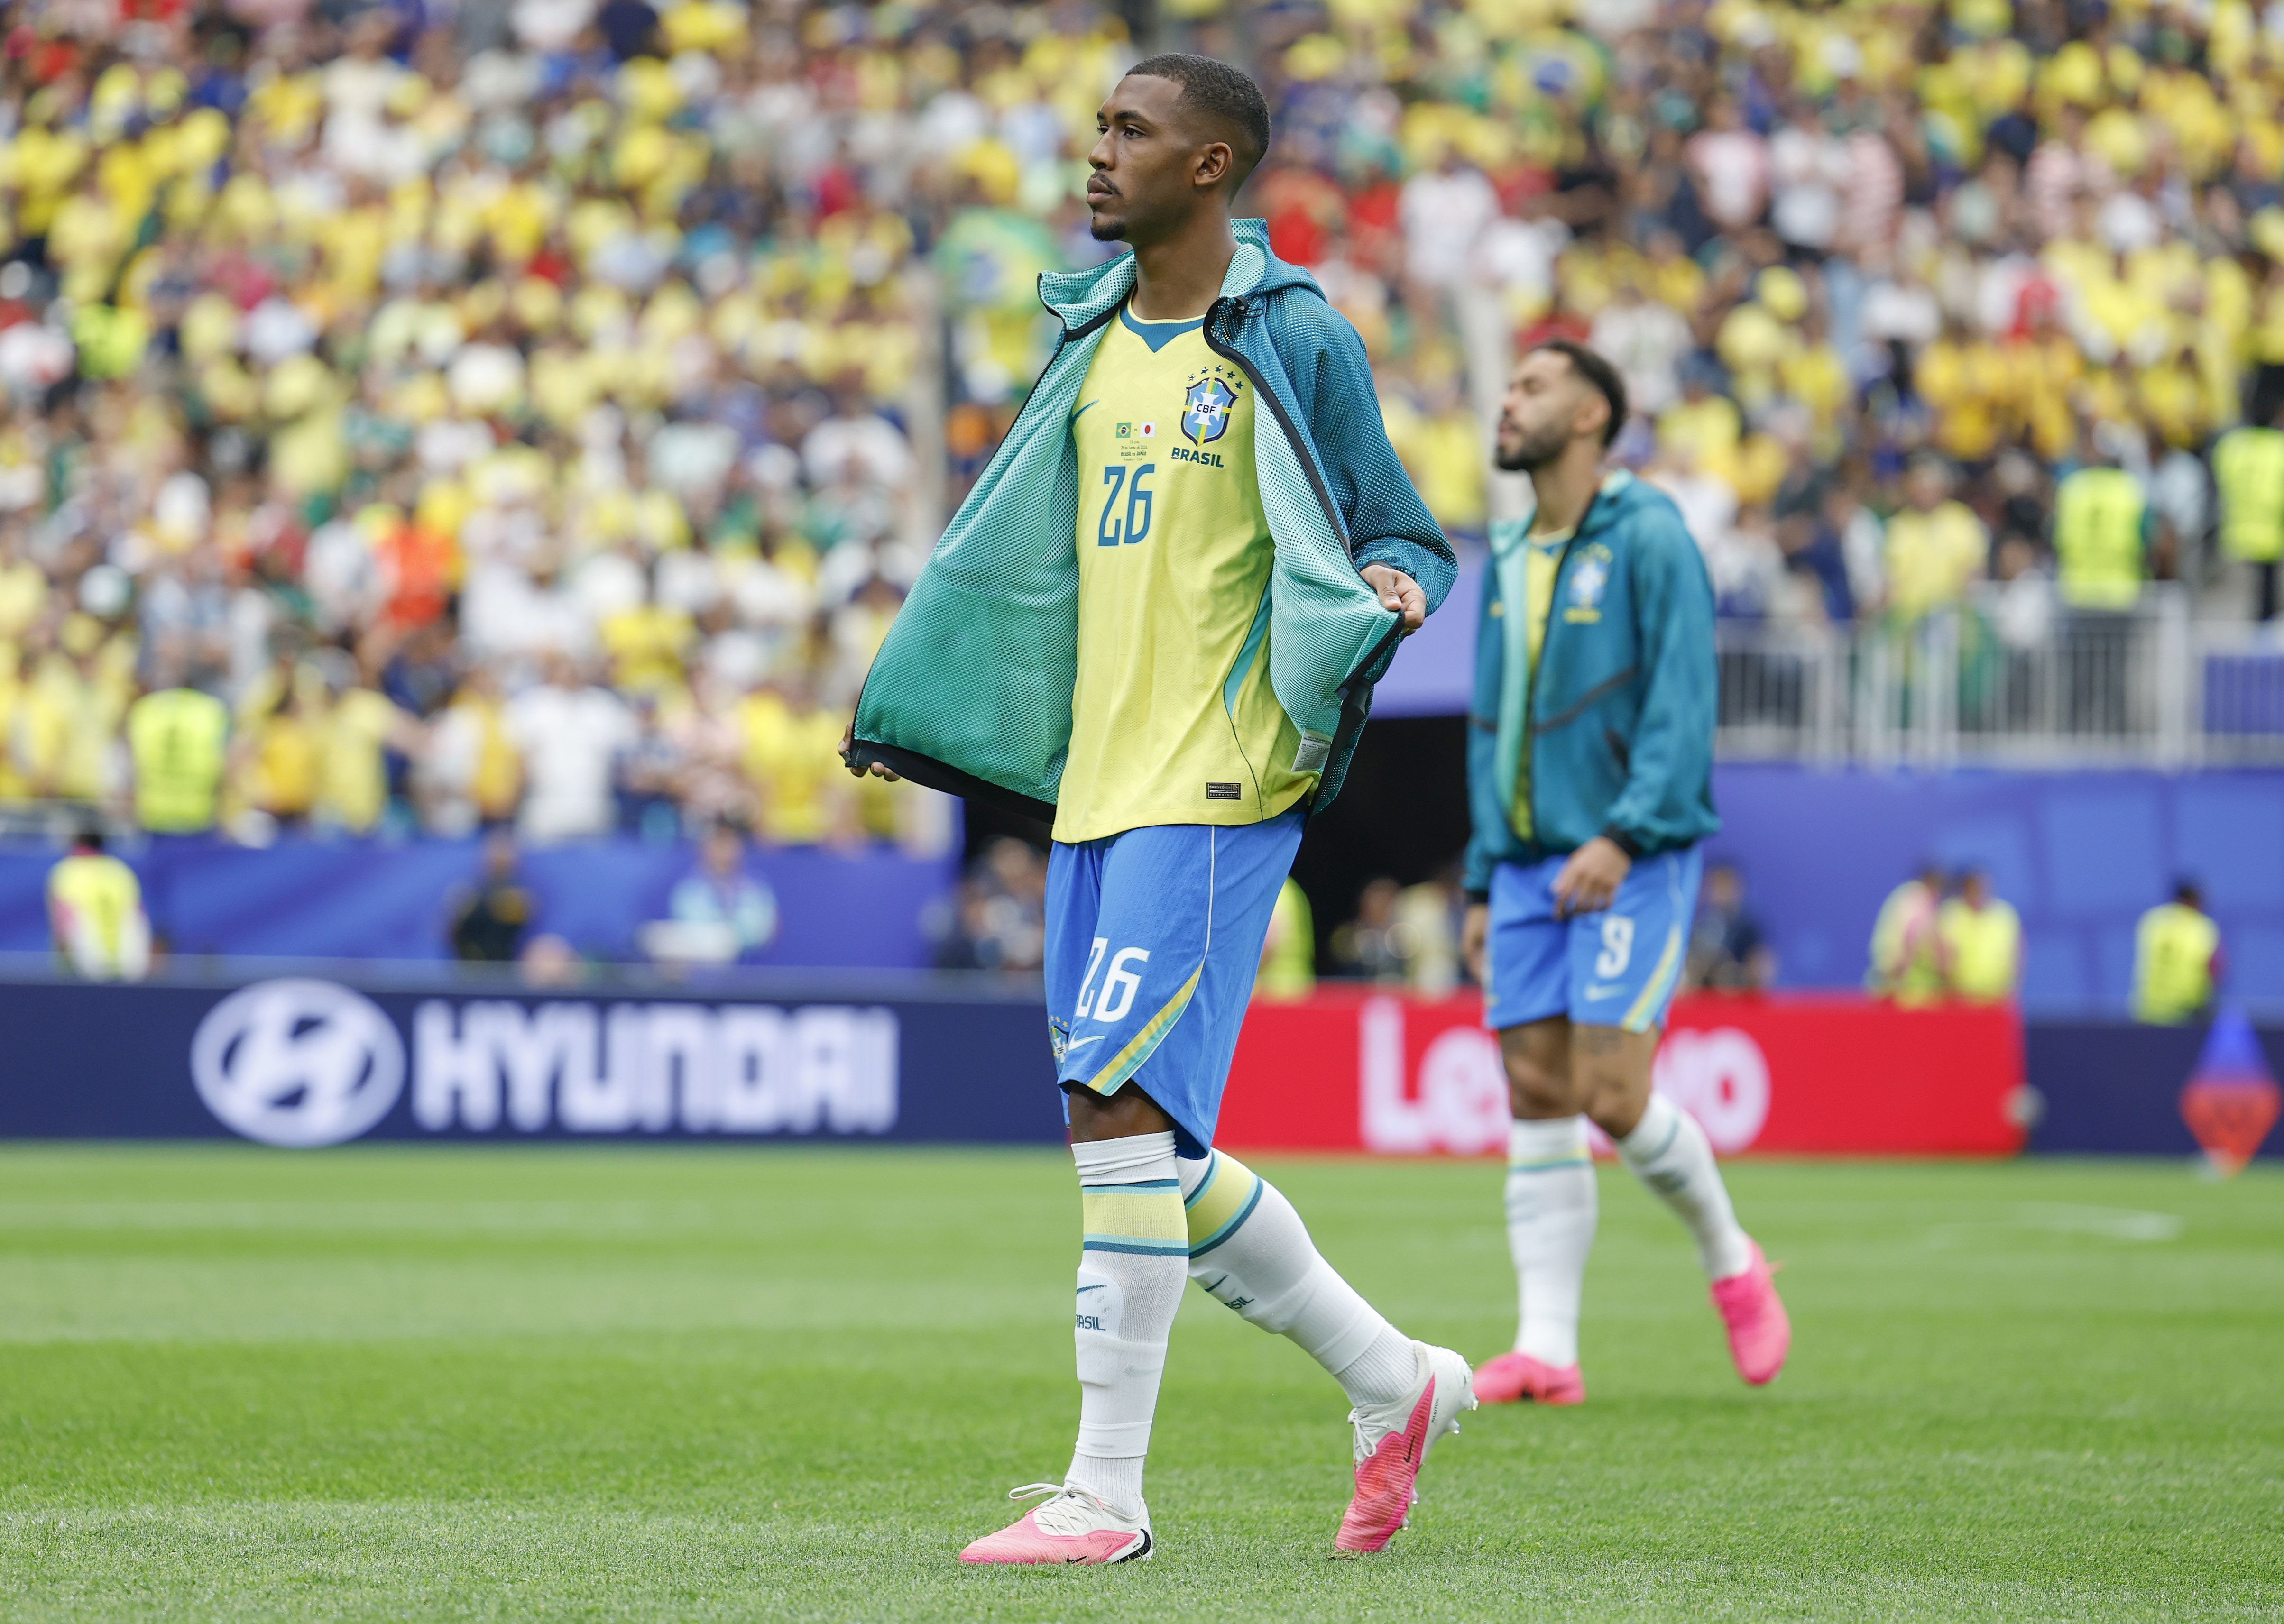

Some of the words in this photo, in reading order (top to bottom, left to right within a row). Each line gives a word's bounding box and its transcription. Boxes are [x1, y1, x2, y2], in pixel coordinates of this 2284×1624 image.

[1197, 404, 1216, 414] CBF
[1170, 447, 1224, 468] BRASIL
[1098, 463, 1155, 547] 26
[1074, 936, 1151, 1023] 26
[1595, 914, 1635, 979] 9
[412, 999, 900, 1133] HYUNDAI
